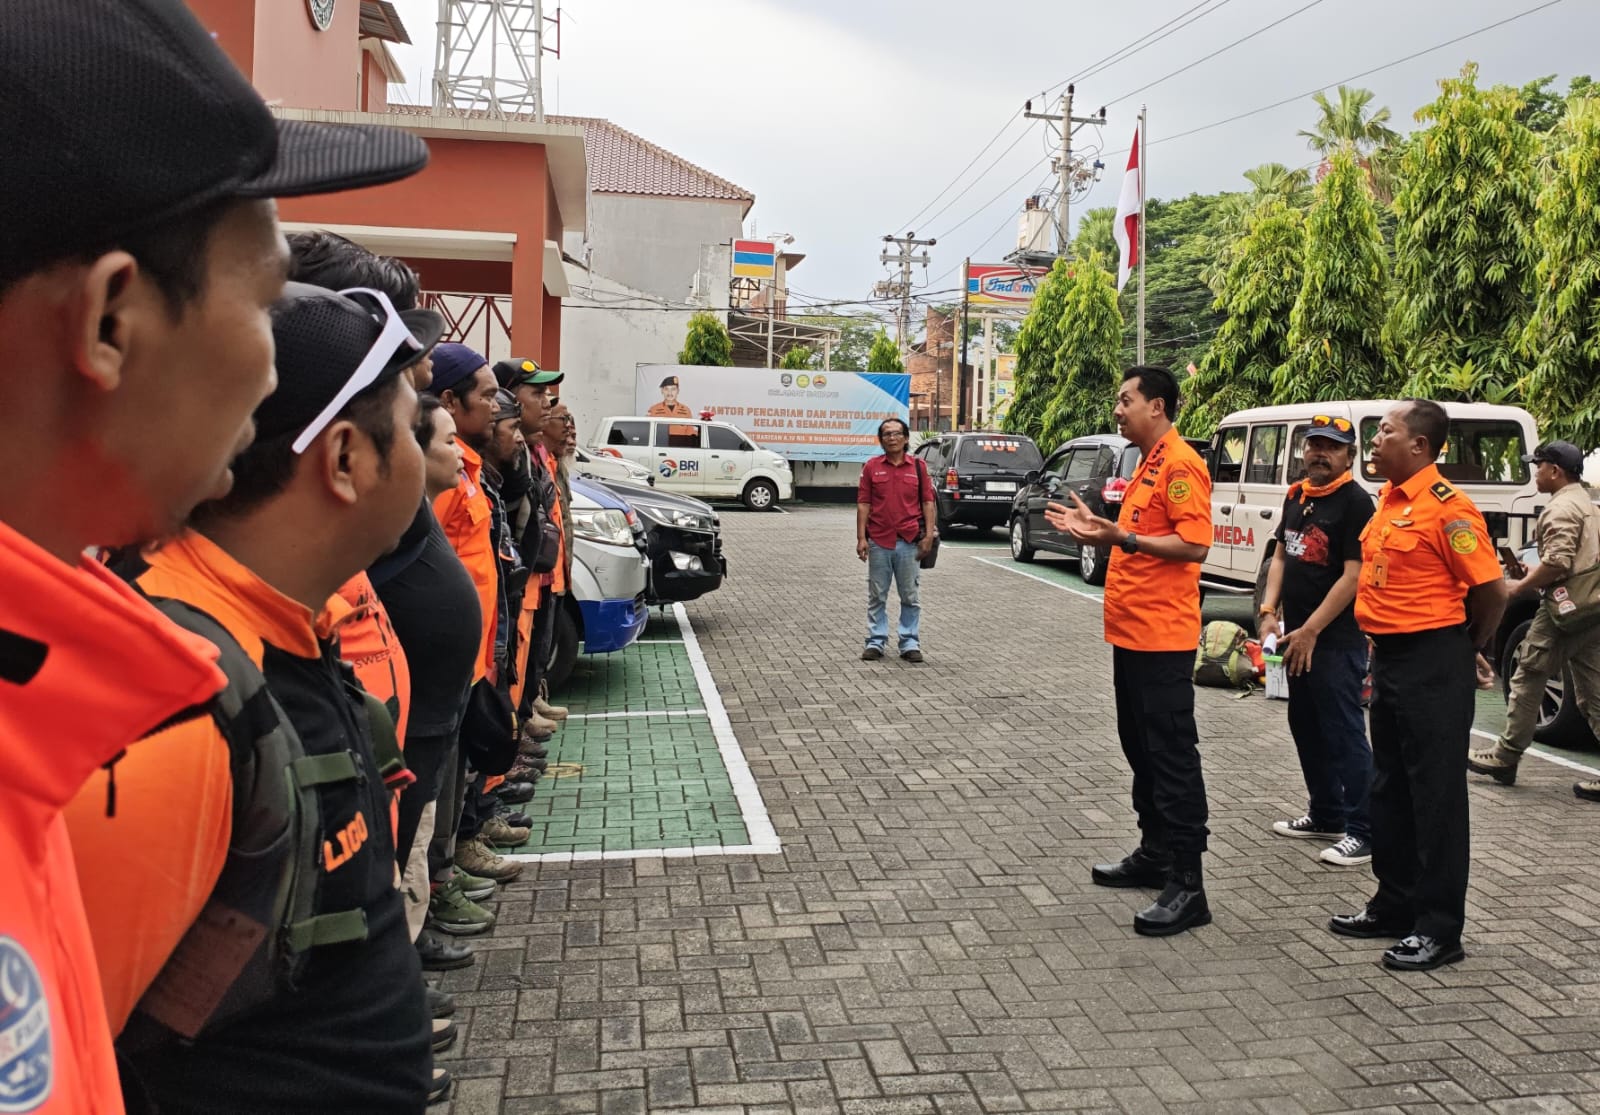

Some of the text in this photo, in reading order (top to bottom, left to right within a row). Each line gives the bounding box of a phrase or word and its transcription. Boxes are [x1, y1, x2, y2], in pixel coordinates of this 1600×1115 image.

[747, 407, 804, 418] PENCARIAN
[806, 409, 827, 419] DAN
[786, 419, 794, 429] A
[796, 419, 852, 430] SEMARANG
[680, 460, 699, 471] BRI
